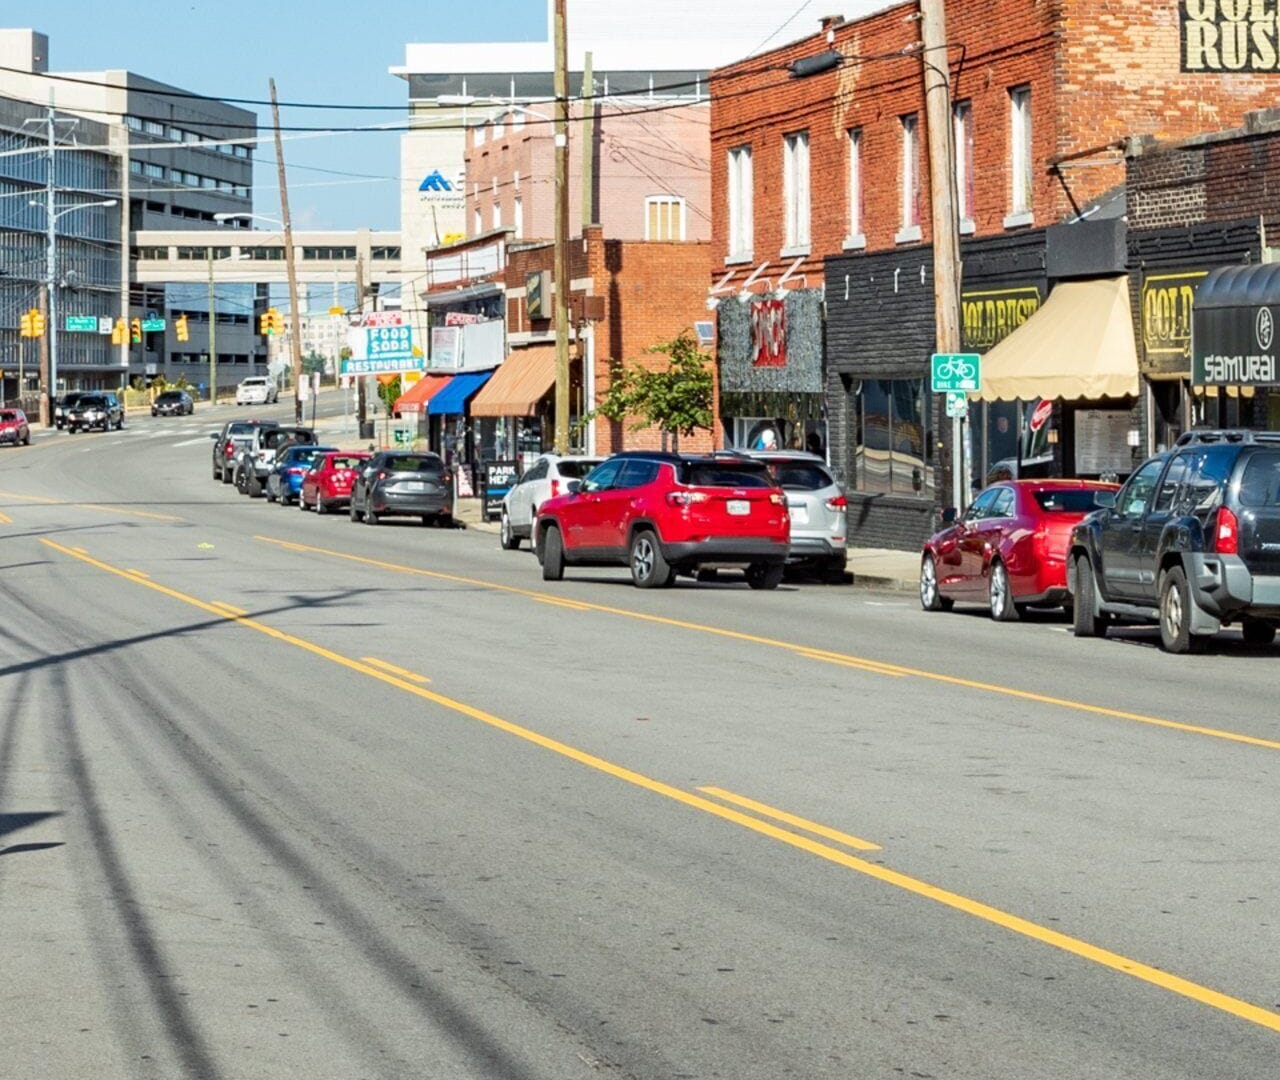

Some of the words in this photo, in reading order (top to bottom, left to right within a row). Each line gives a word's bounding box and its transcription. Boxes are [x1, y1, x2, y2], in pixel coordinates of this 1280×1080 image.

[370, 328, 409, 340] FOOD
[371, 340, 410, 352] SODA
[346, 358, 420, 373] RESTAURANT
[1204, 354, 1275, 382] SAMURAI
[488, 466, 515, 475] PARK
